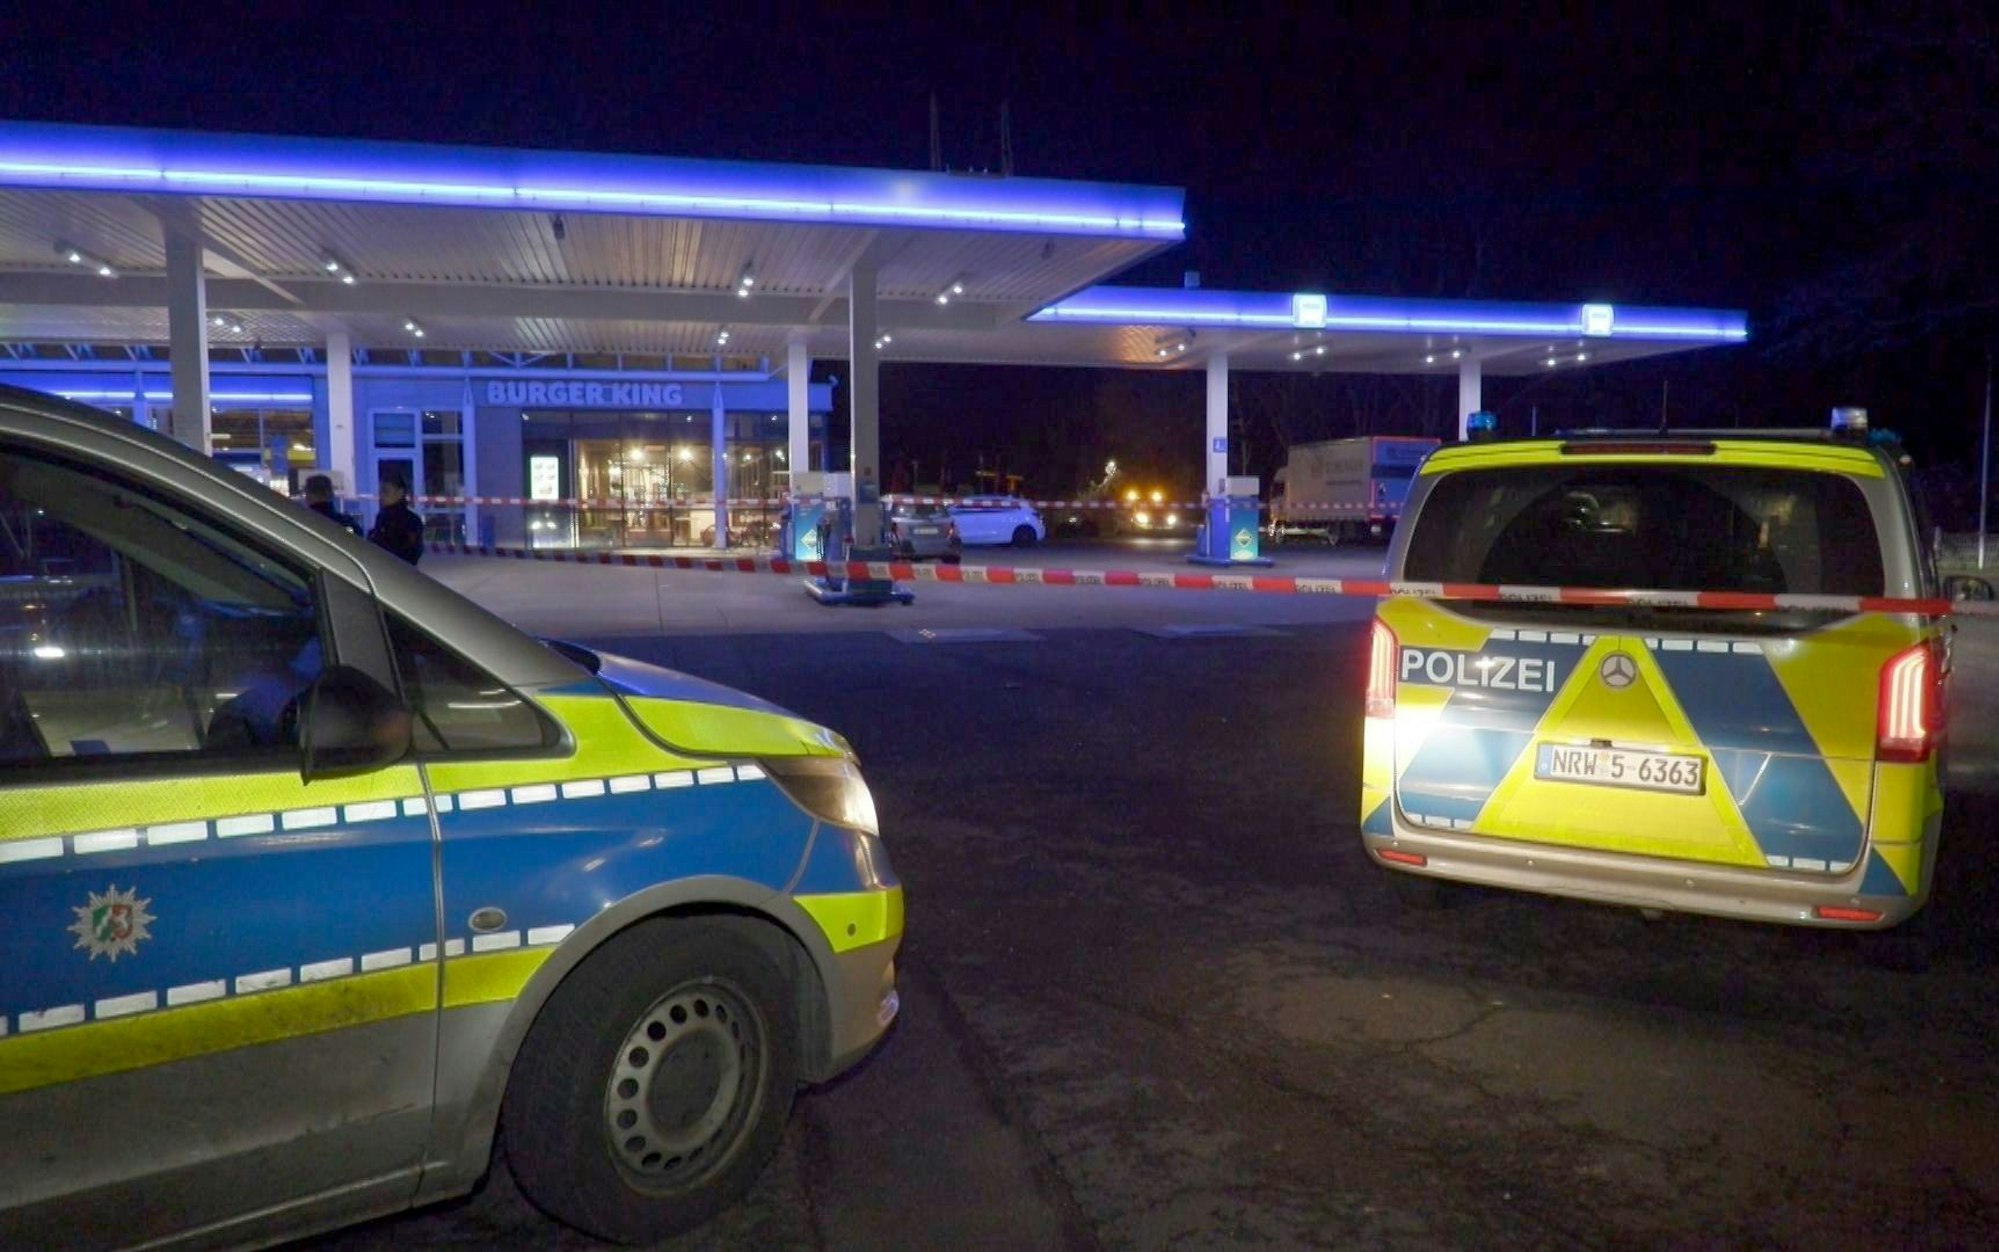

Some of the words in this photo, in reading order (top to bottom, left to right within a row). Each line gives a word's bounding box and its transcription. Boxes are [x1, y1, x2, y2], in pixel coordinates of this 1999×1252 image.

[487, 380, 603, 404] BURGER
[611, 382, 682, 405] KING
[1401, 649, 1555, 692] POLIZEI
[1553, 749, 1597, 775] NRW
[1638, 758, 1699, 786] 6363
